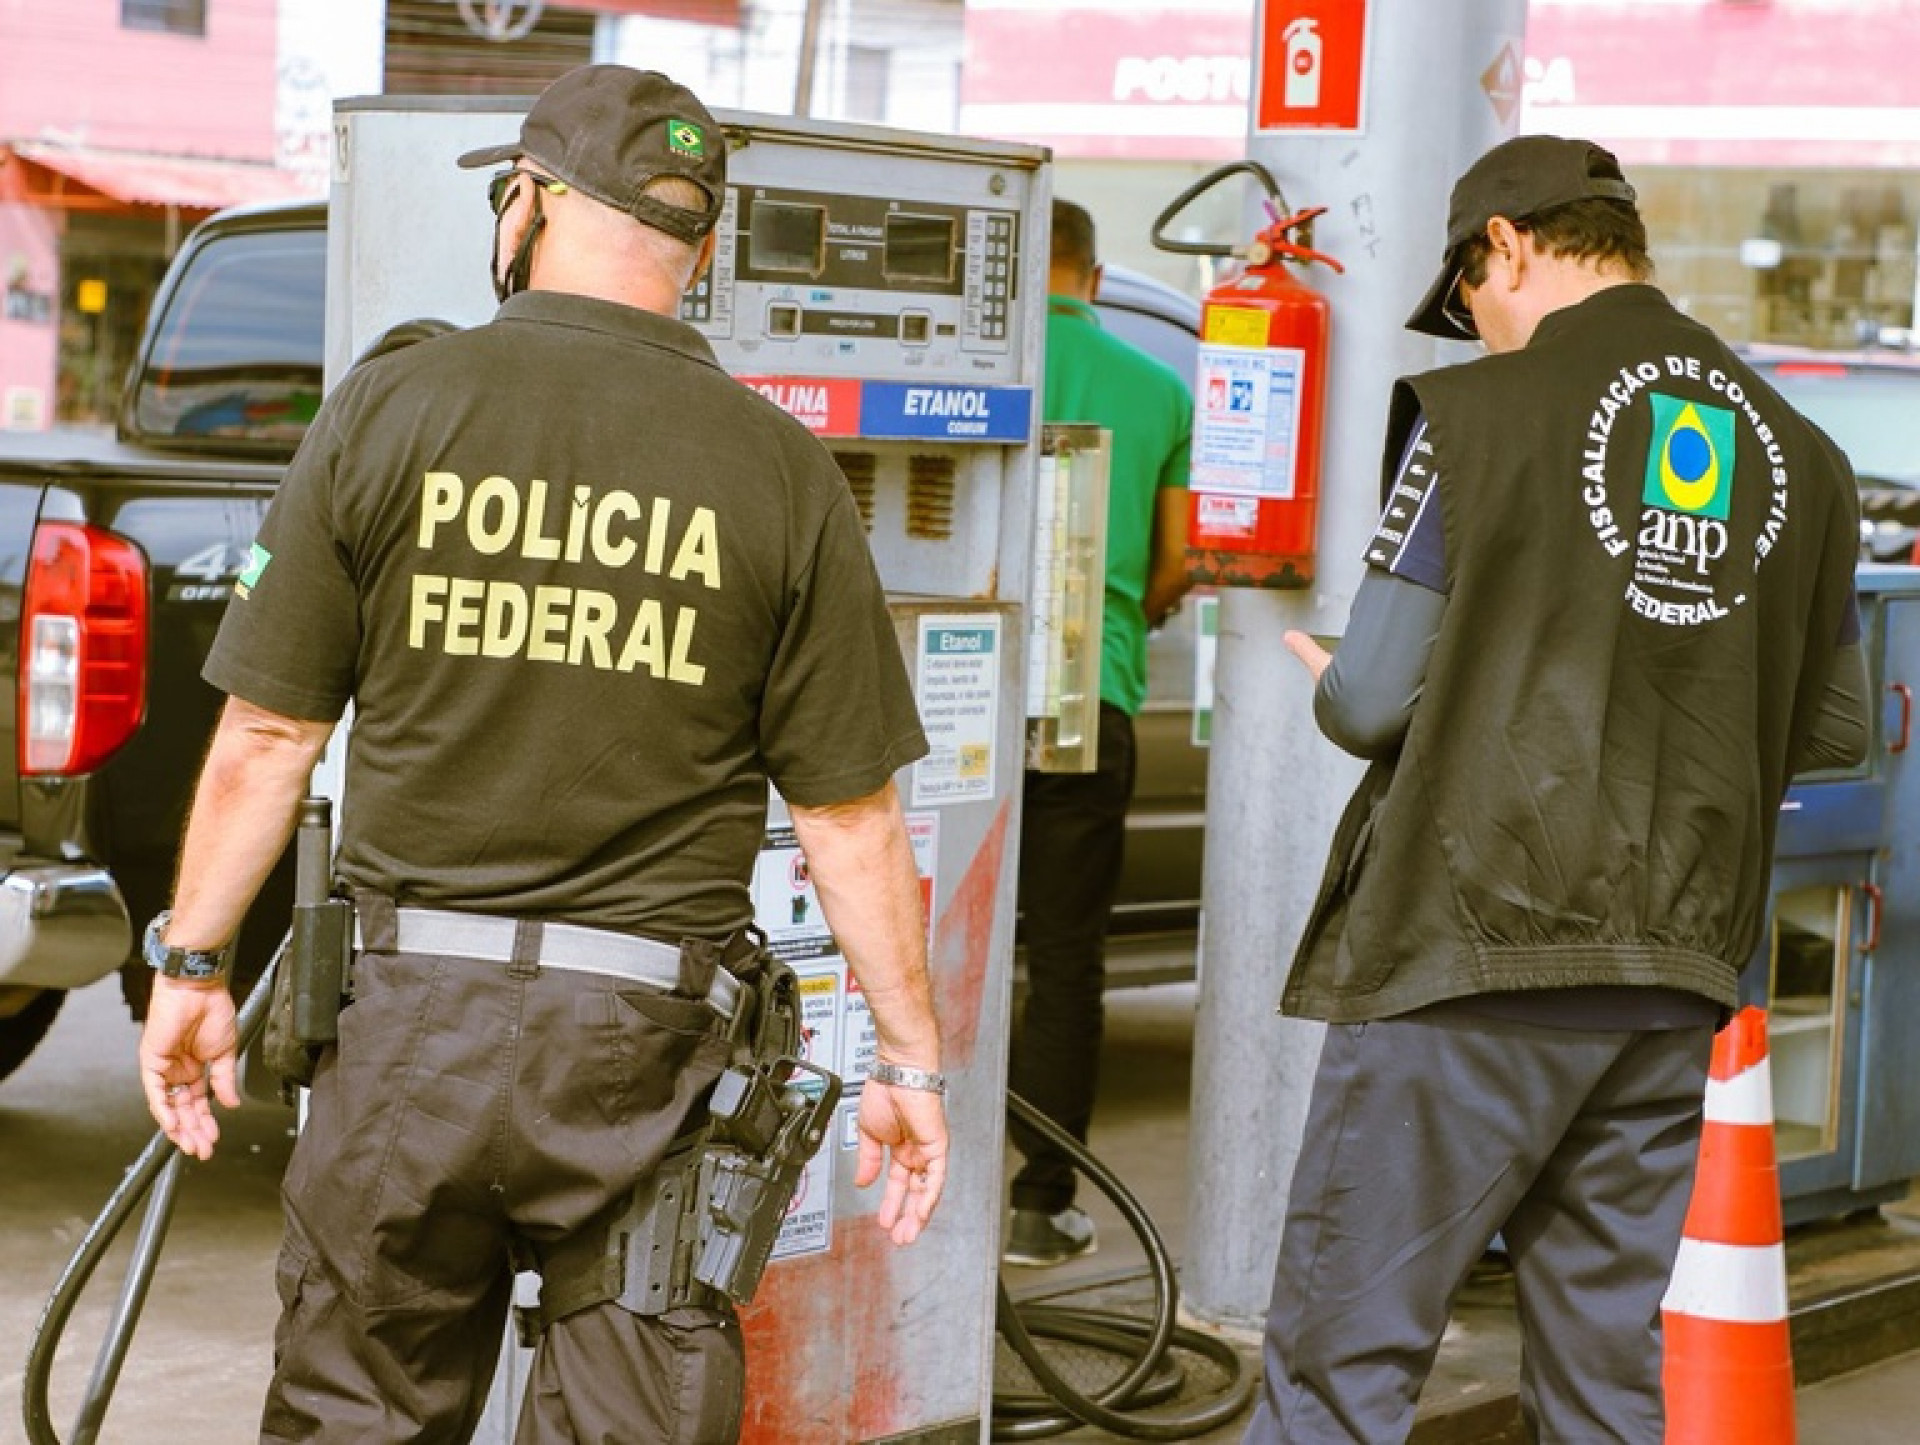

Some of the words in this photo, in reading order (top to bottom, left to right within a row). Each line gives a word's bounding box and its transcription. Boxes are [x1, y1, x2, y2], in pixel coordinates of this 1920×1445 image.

[1665, 355, 1701, 381] DE
[904, 389, 990, 417] ETANOL
[1582, 361, 1660, 558] FISCALIZAÇÃO
[417, 471, 721, 590] POLÍCIA
[1638, 509, 1729, 575] anp
[408, 574, 706, 686] FEDERAL
[1624, 580, 1730, 626] FEDERAL
[939, 631, 982, 651] Etanol
